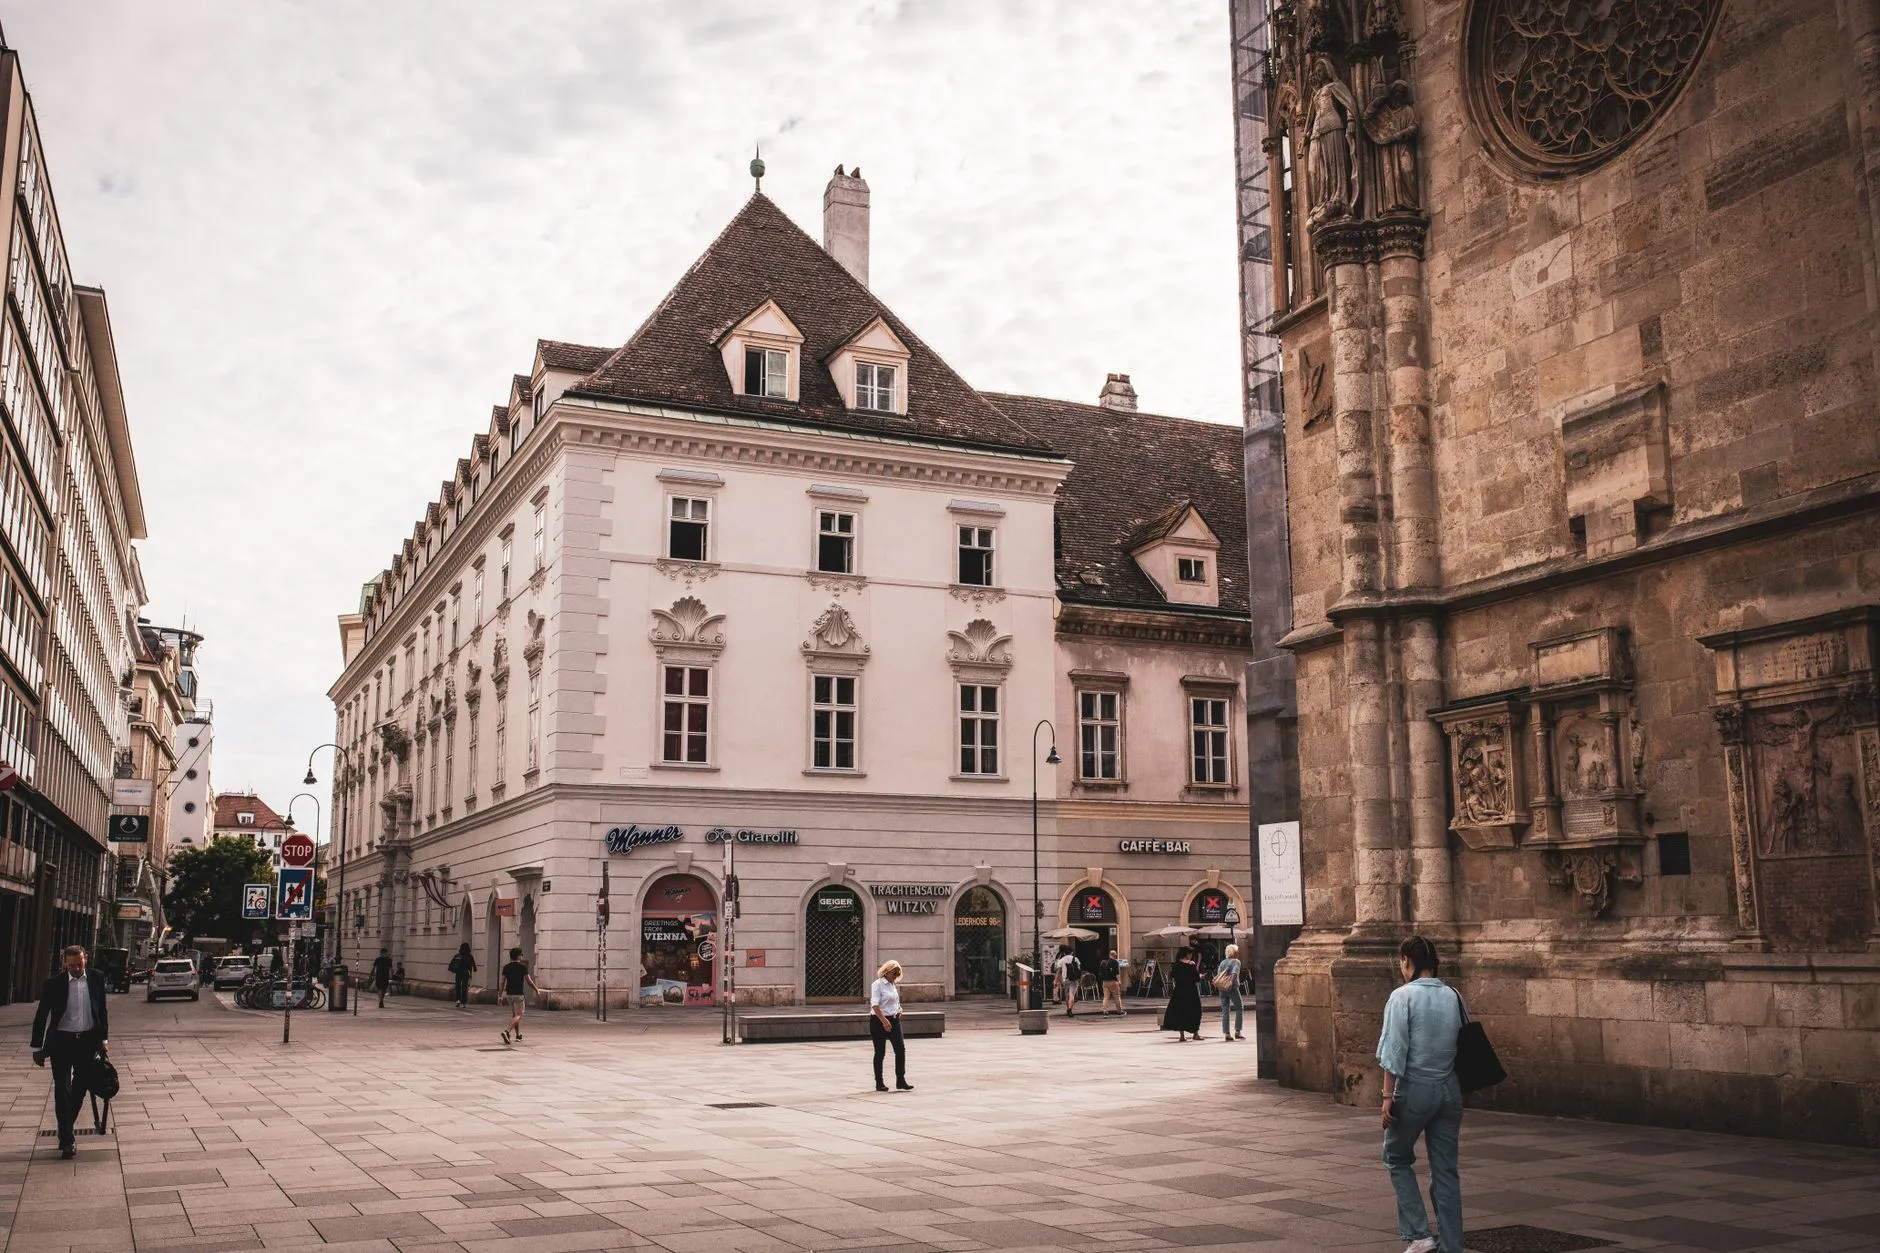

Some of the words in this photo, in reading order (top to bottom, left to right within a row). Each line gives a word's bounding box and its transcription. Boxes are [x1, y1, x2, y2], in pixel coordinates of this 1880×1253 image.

[606, 824, 684, 854] Manner
[737, 830, 795, 843] Giarolli
[284, 844, 312, 857] STOP
[872, 885, 951, 896] TRACHTENSALON
[887, 901, 937, 913] WITZKY
[955, 917, 987, 926] LEDERHOSE
[643, 932, 688, 941] VIENNA
